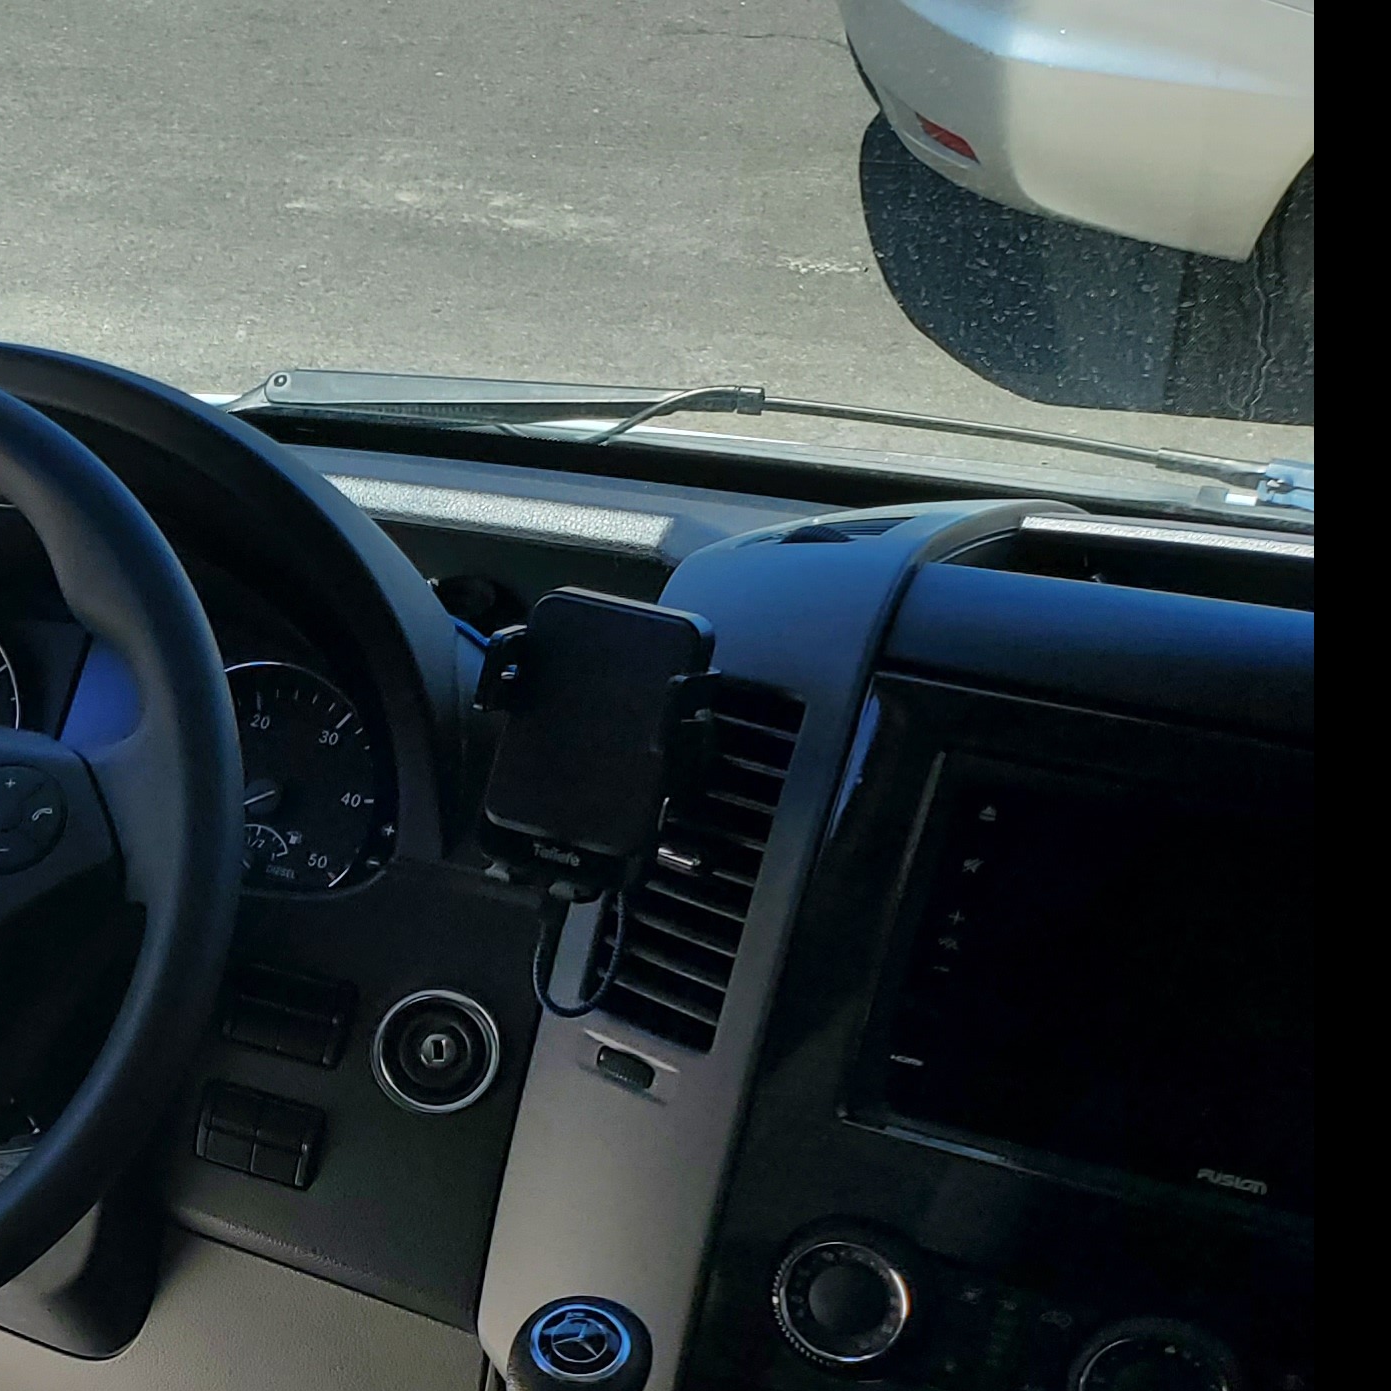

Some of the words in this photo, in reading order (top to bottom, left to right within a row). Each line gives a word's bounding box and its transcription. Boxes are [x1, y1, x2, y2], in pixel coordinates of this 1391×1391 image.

[250, 713, 271, 730] 20
[318, 729, 339, 746] 30
[340, 792, 362, 808] 40
[307, 853, 328, 869] 50
